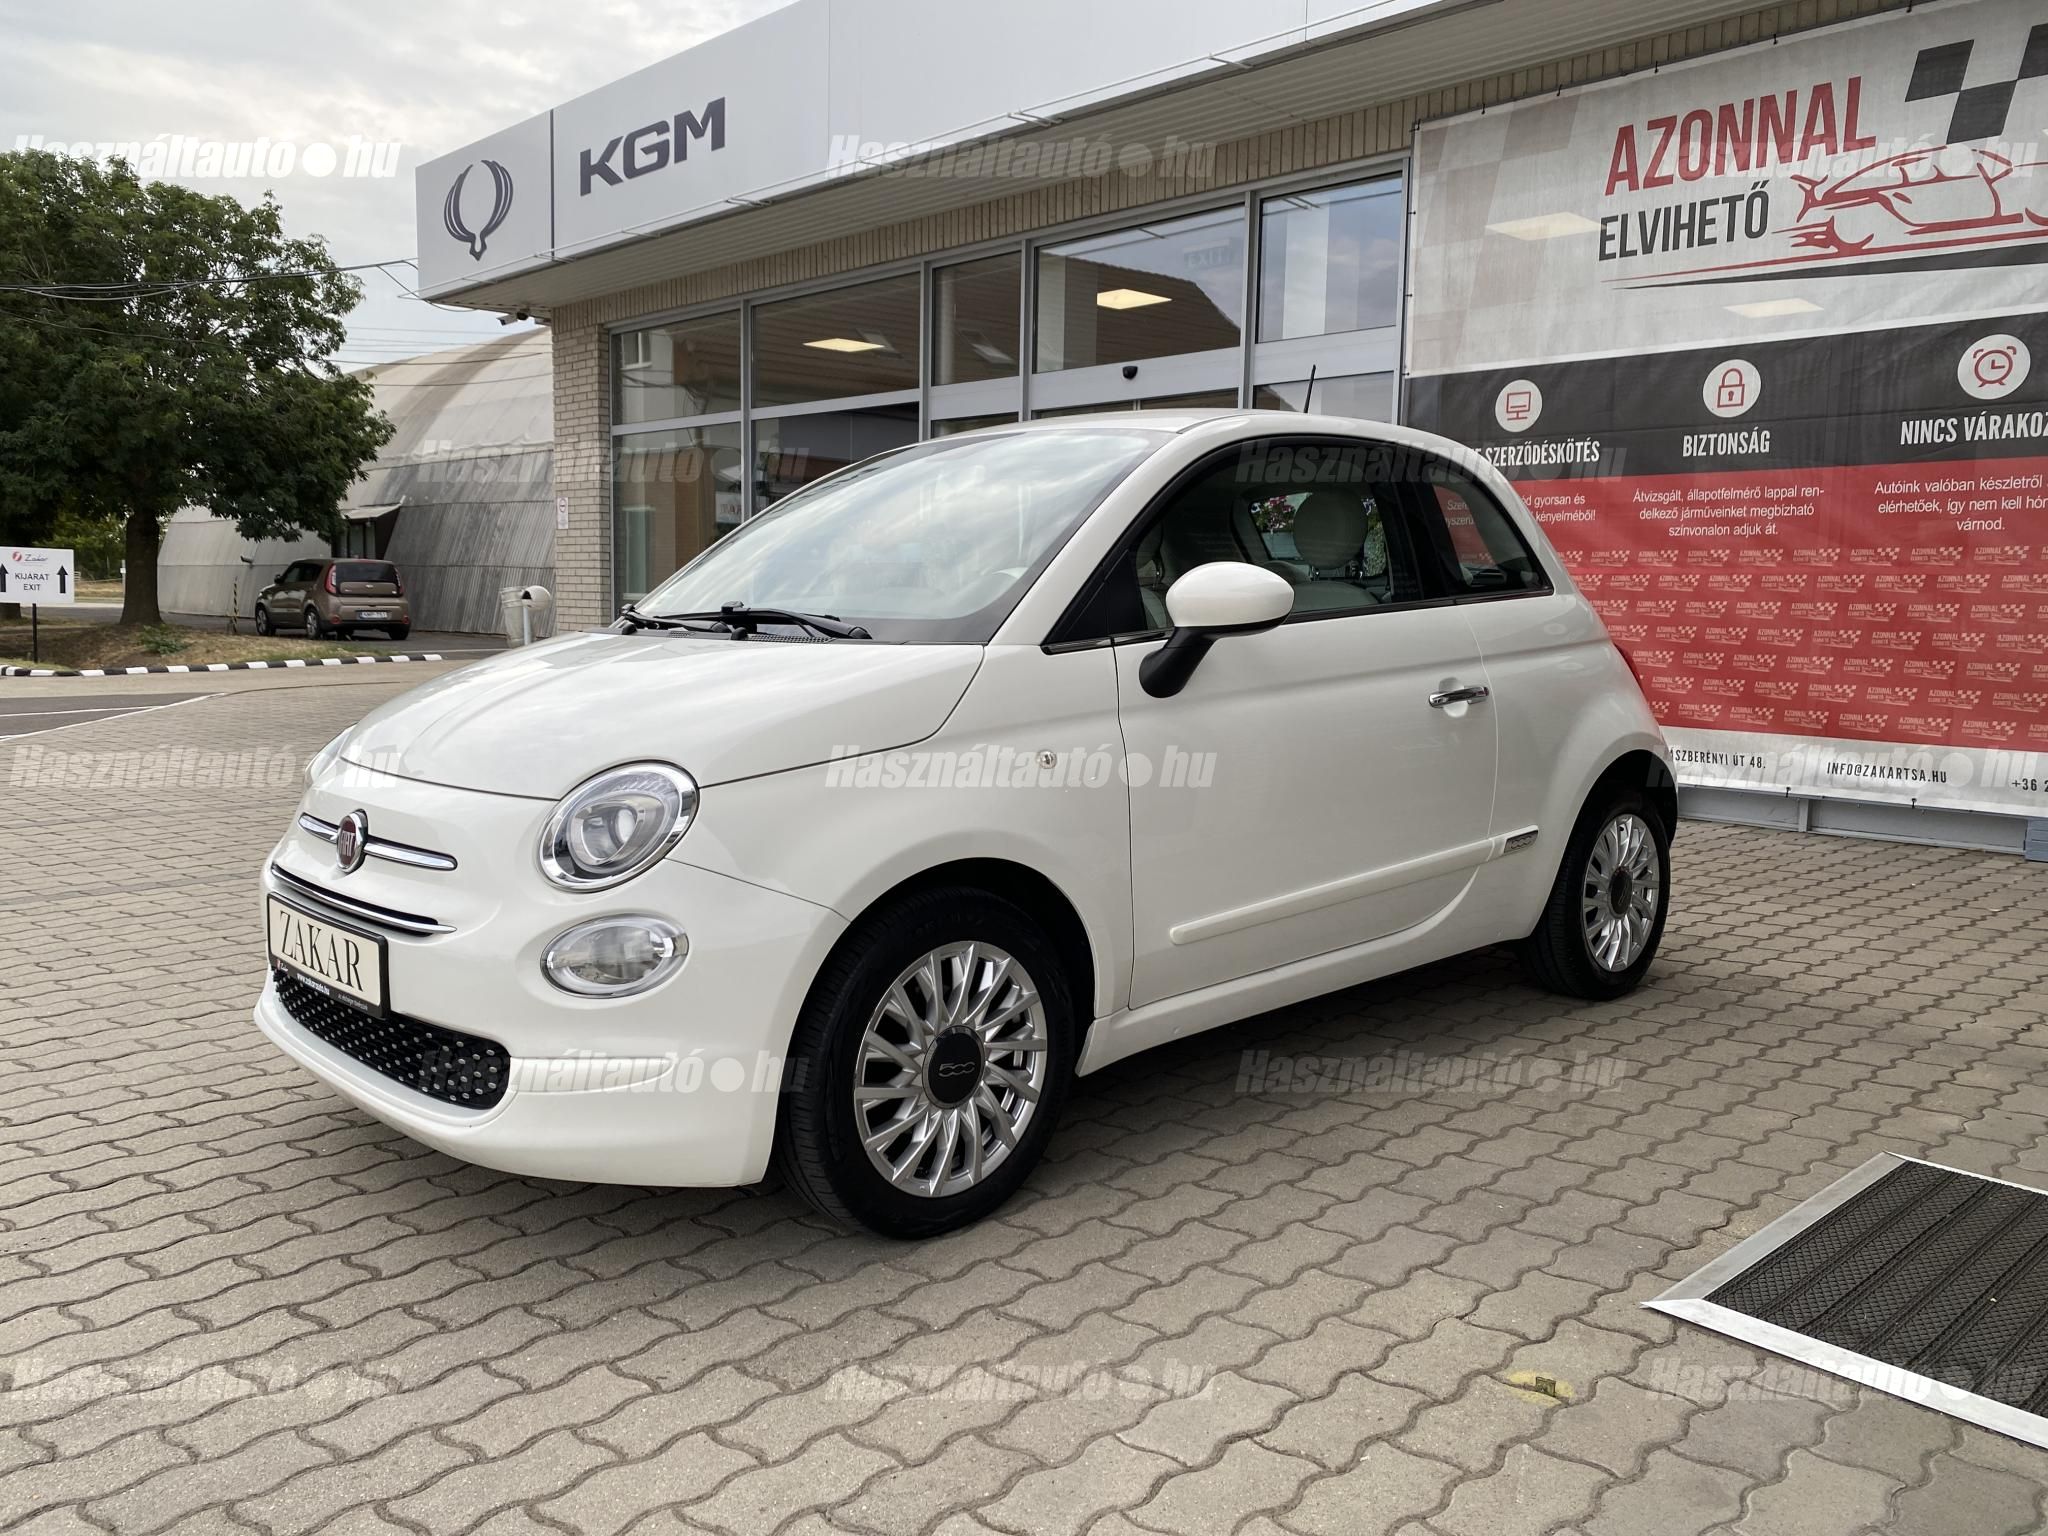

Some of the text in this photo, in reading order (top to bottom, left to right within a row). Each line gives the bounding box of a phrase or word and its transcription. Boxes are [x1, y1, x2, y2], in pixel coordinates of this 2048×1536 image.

[1605, 76, 1876, 196] AZONNAL
[580, 97, 725, 196] KGM
[1599, 180, 1769, 261] ELVIHETŐ
[1900, 418, 1958, 445] NINCS
[1682, 427, 1770, 457] BIZTONSÁG
[1485, 437, 1600, 467] SZERZŐDÉSKÖTÉS
[1633, 485, 1825, 504] Átvizsgált, állapotfelmérő lappal ren-
[1874, 475, 2043, 495] Autóink valóban készletről
[1534, 496, 1571, 508] gyorsan
[1574, 494, 1586, 504] és
[1878, 498, 1942, 514] elérhetőek,
[1946, 498, 1965, 515] így
[1969, 500, 1997, 510] nem
[2001, 496, 2022, 510] kell
[1536, 510, 1596, 524] kényelméből!
[1639, 503, 1815, 522] delkező járműveinket megbízható
[1669, 522, 1778, 538] színvonalon adjuk át.
[1956, 517, 2006, 531] várnod.
[1750, 756, 1766, 769] 48.
[1827, 762, 1947, 783] INFO@ZAKARTSA.HU
[2012, 778, 2037, 791] +36
[280, 911, 363, 992] ZAKAR
[938, 1062, 975, 1077] 500
